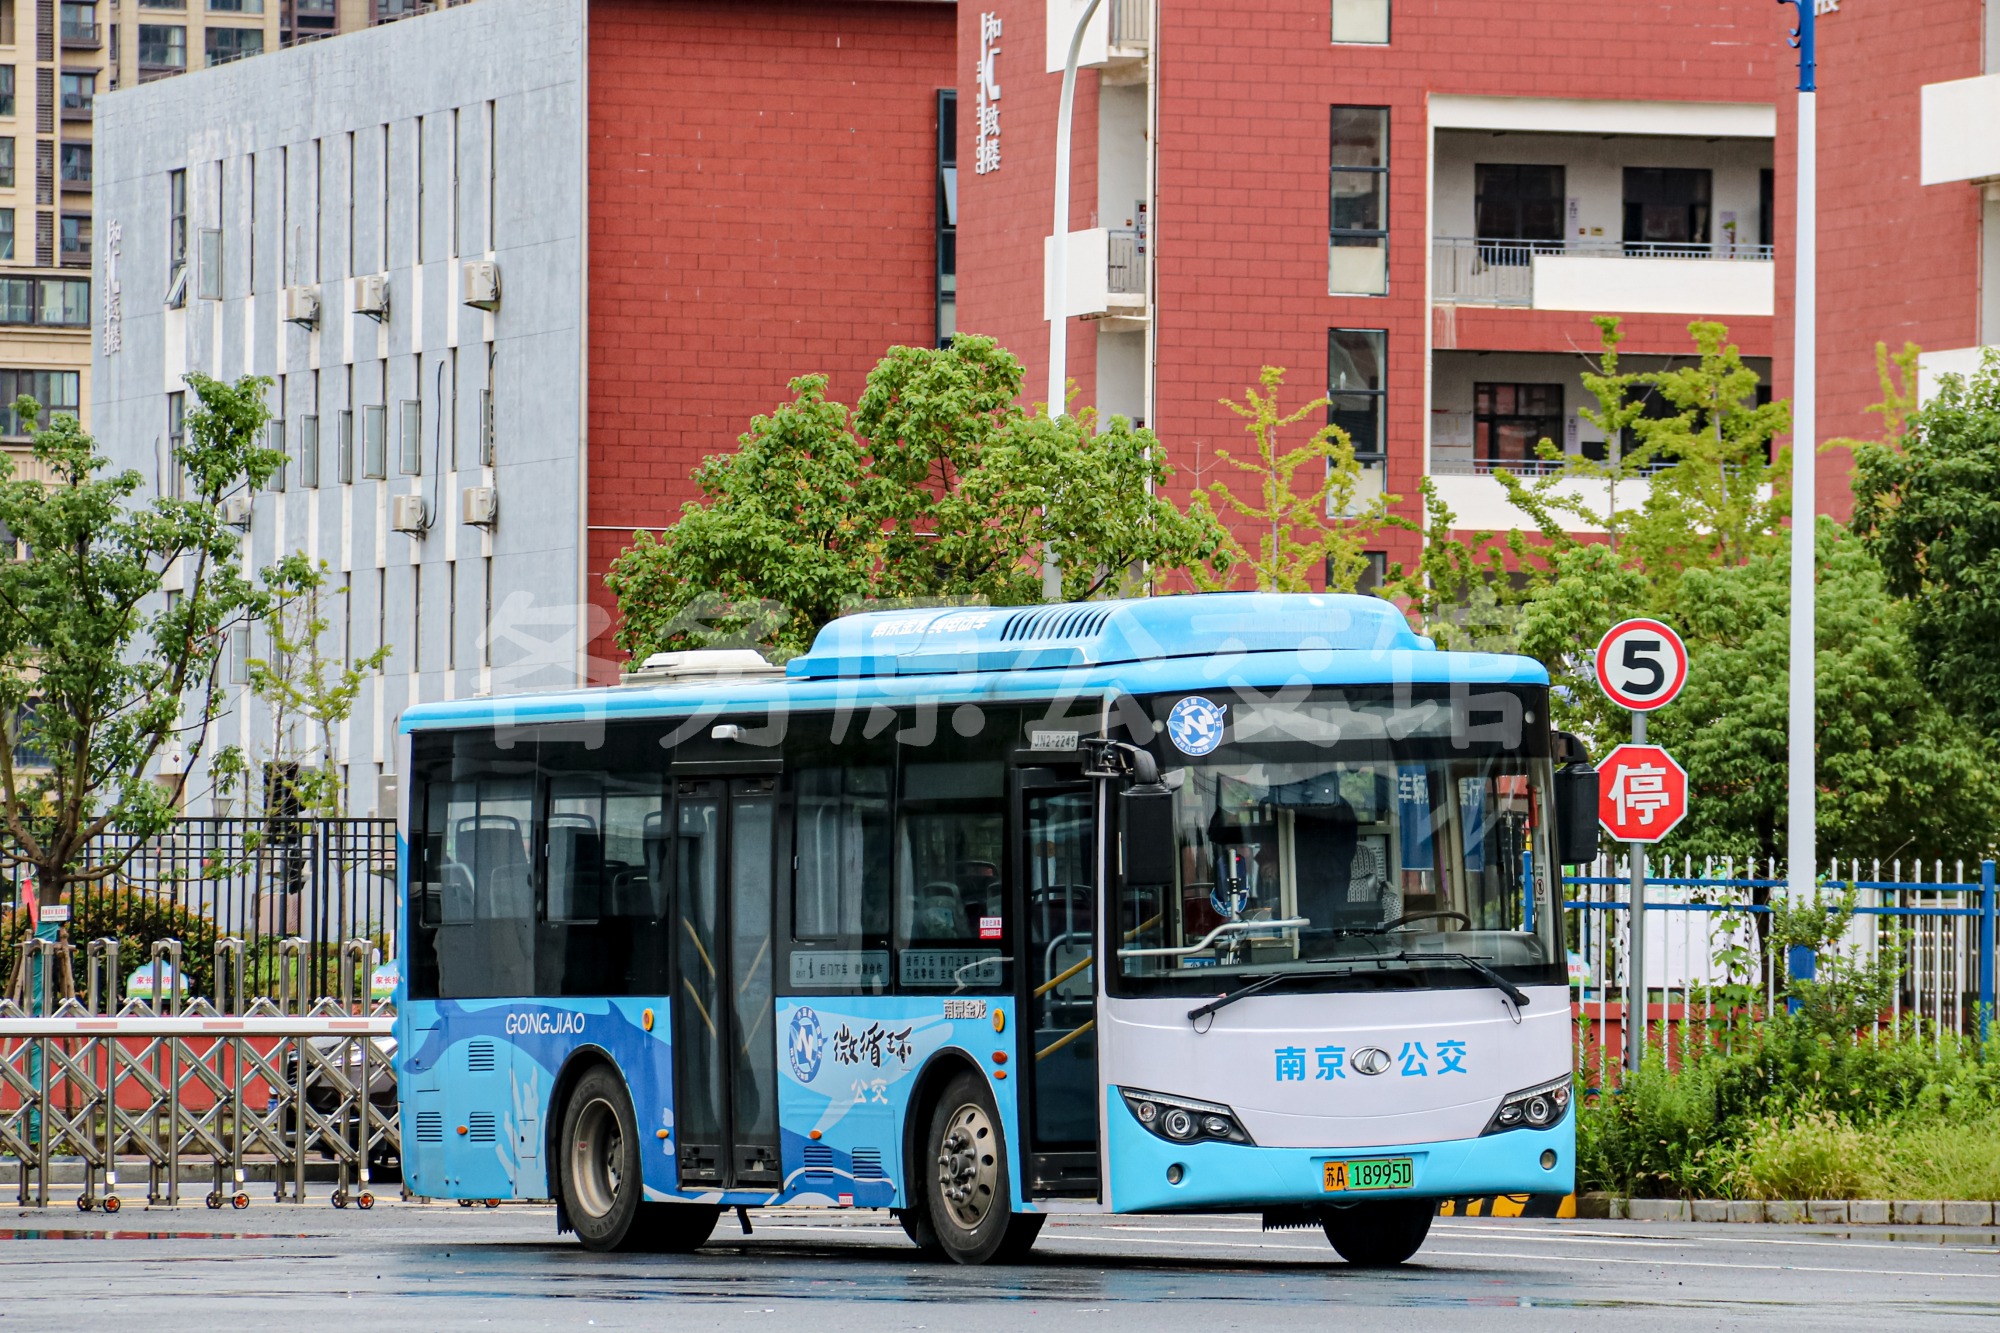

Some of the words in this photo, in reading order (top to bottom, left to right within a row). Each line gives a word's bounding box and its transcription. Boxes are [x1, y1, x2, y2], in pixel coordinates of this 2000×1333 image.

[1621, 640, 1665, 695] 5
[1034, 734, 1076, 748] JN2-2245
[1607, 762, 1671, 827] 停
[820, 963, 848, 976] 后门下车
[943, 999, 987, 1019] 南京金龙
[505, 1012, 586, 1035] GONGJIAO
[833, 1021, 913, 1068] 微循环
[1274, 1045, 1346, 1082] 南京
[1398, 1039, 1467, 1077] 公交
[851, 1078, 889, 1104] 公交
[1354, 1163, 1412, 1186] 18995D
